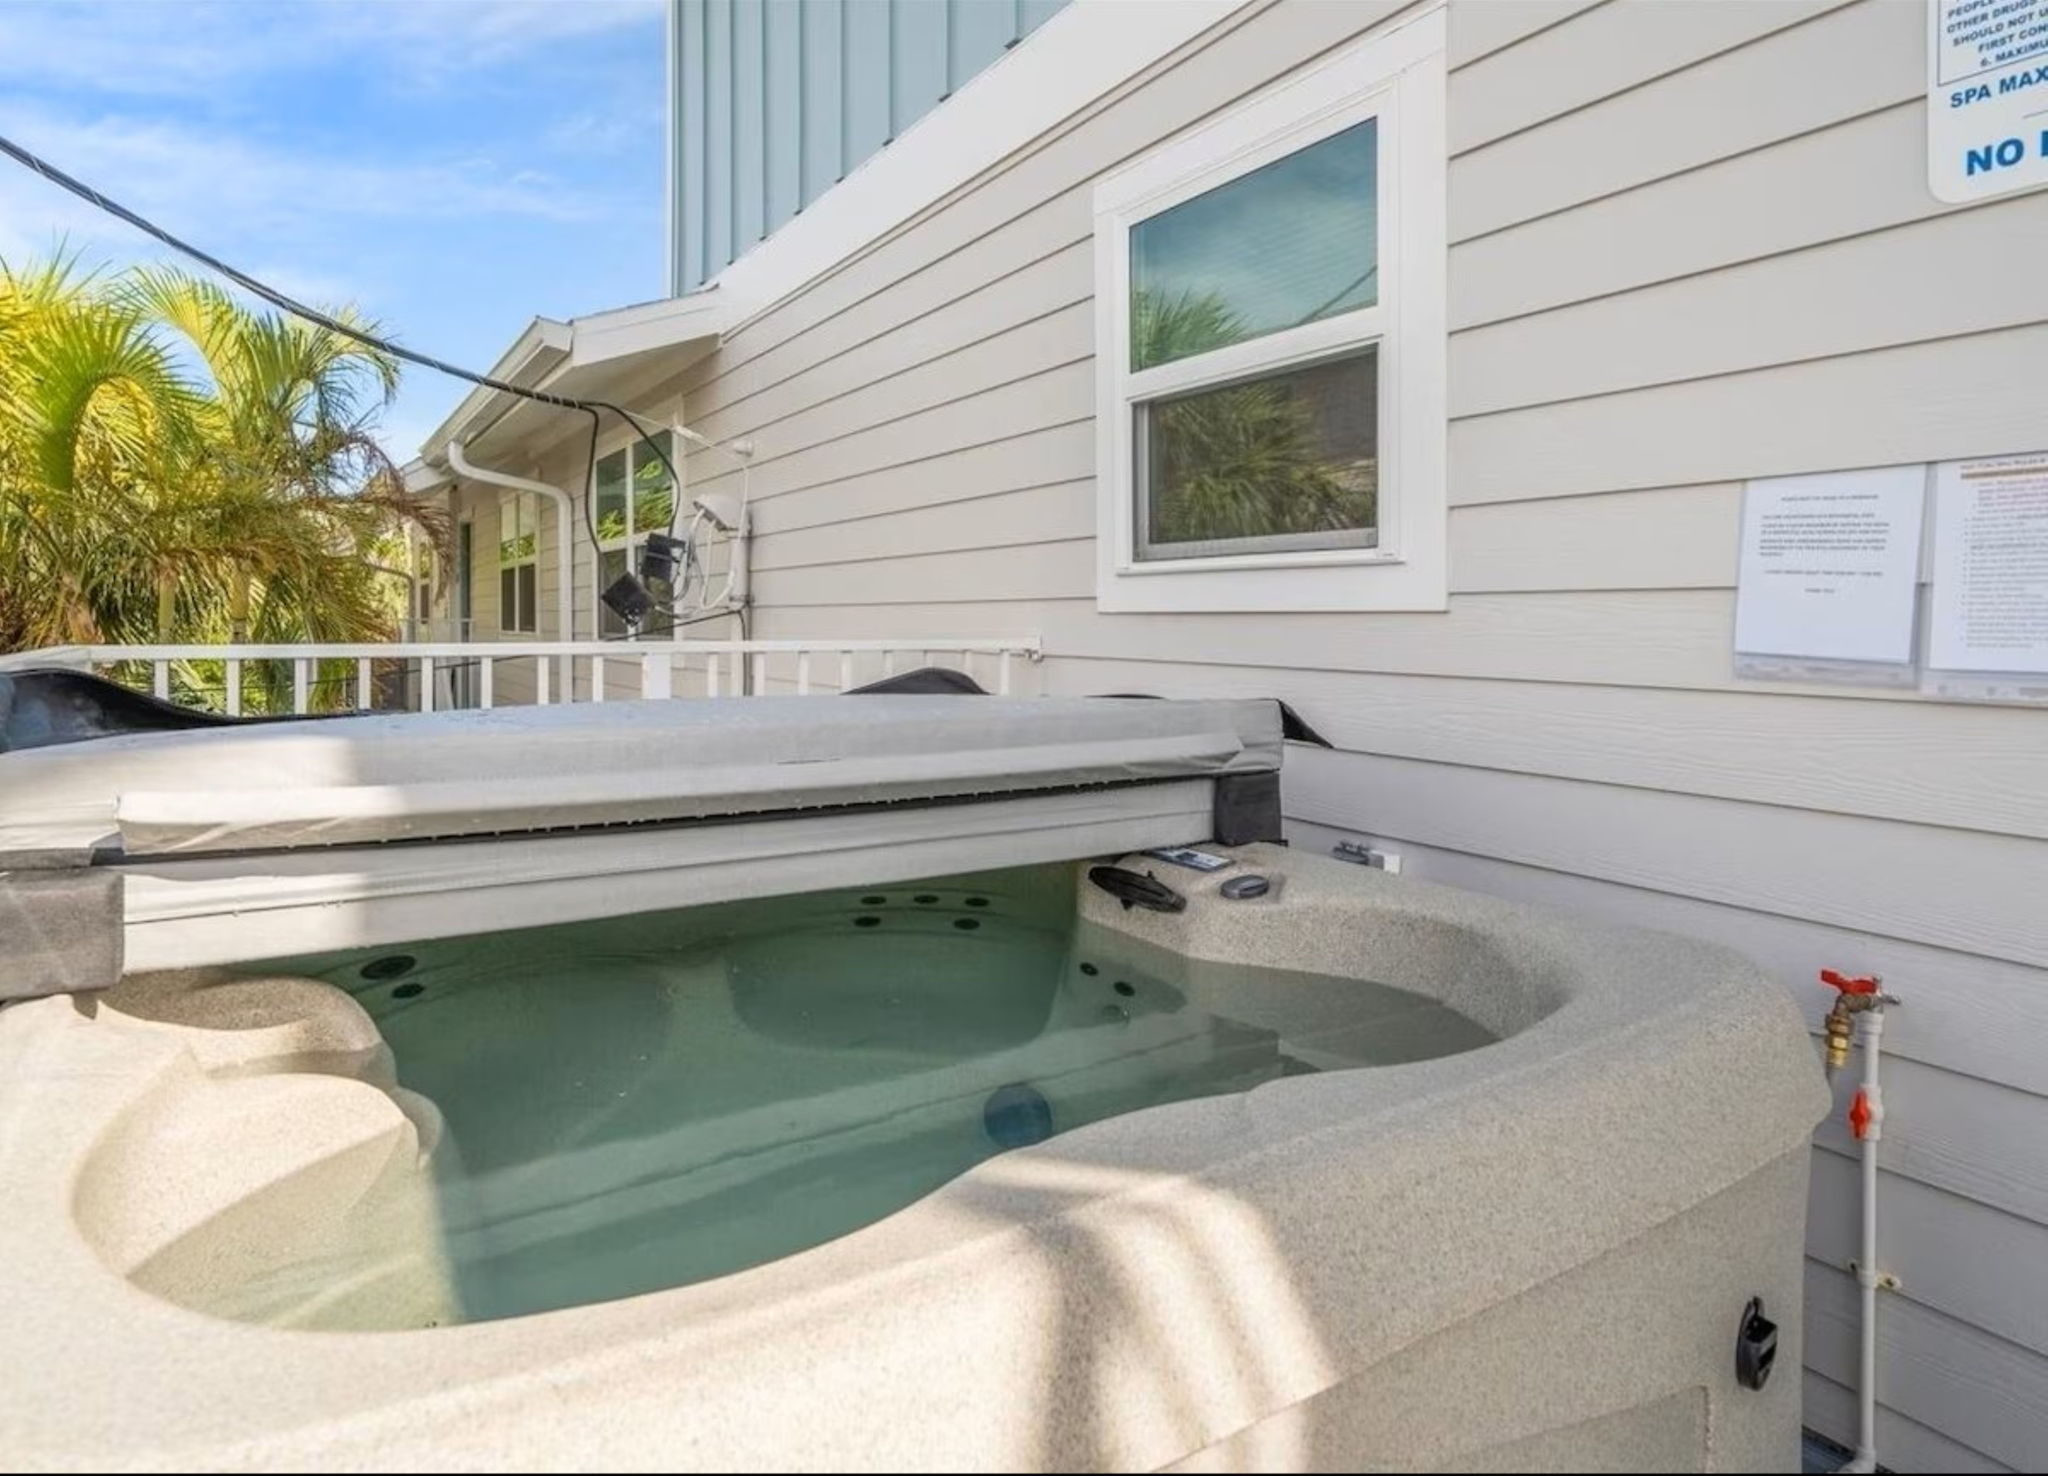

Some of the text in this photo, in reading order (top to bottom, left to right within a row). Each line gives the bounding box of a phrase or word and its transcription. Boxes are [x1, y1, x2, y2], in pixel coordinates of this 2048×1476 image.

[1947, 0, 2037, 33] OTHER DRUGS
[1953, 22, 2004, 47] SHOULD
[2007, 12, 2034, 28] NOT
[1978, 33, 2014, 52] FIRST
[1950, 65, 2048, 108] SPA MAX
[1966, 138, 2024, 176] NO
